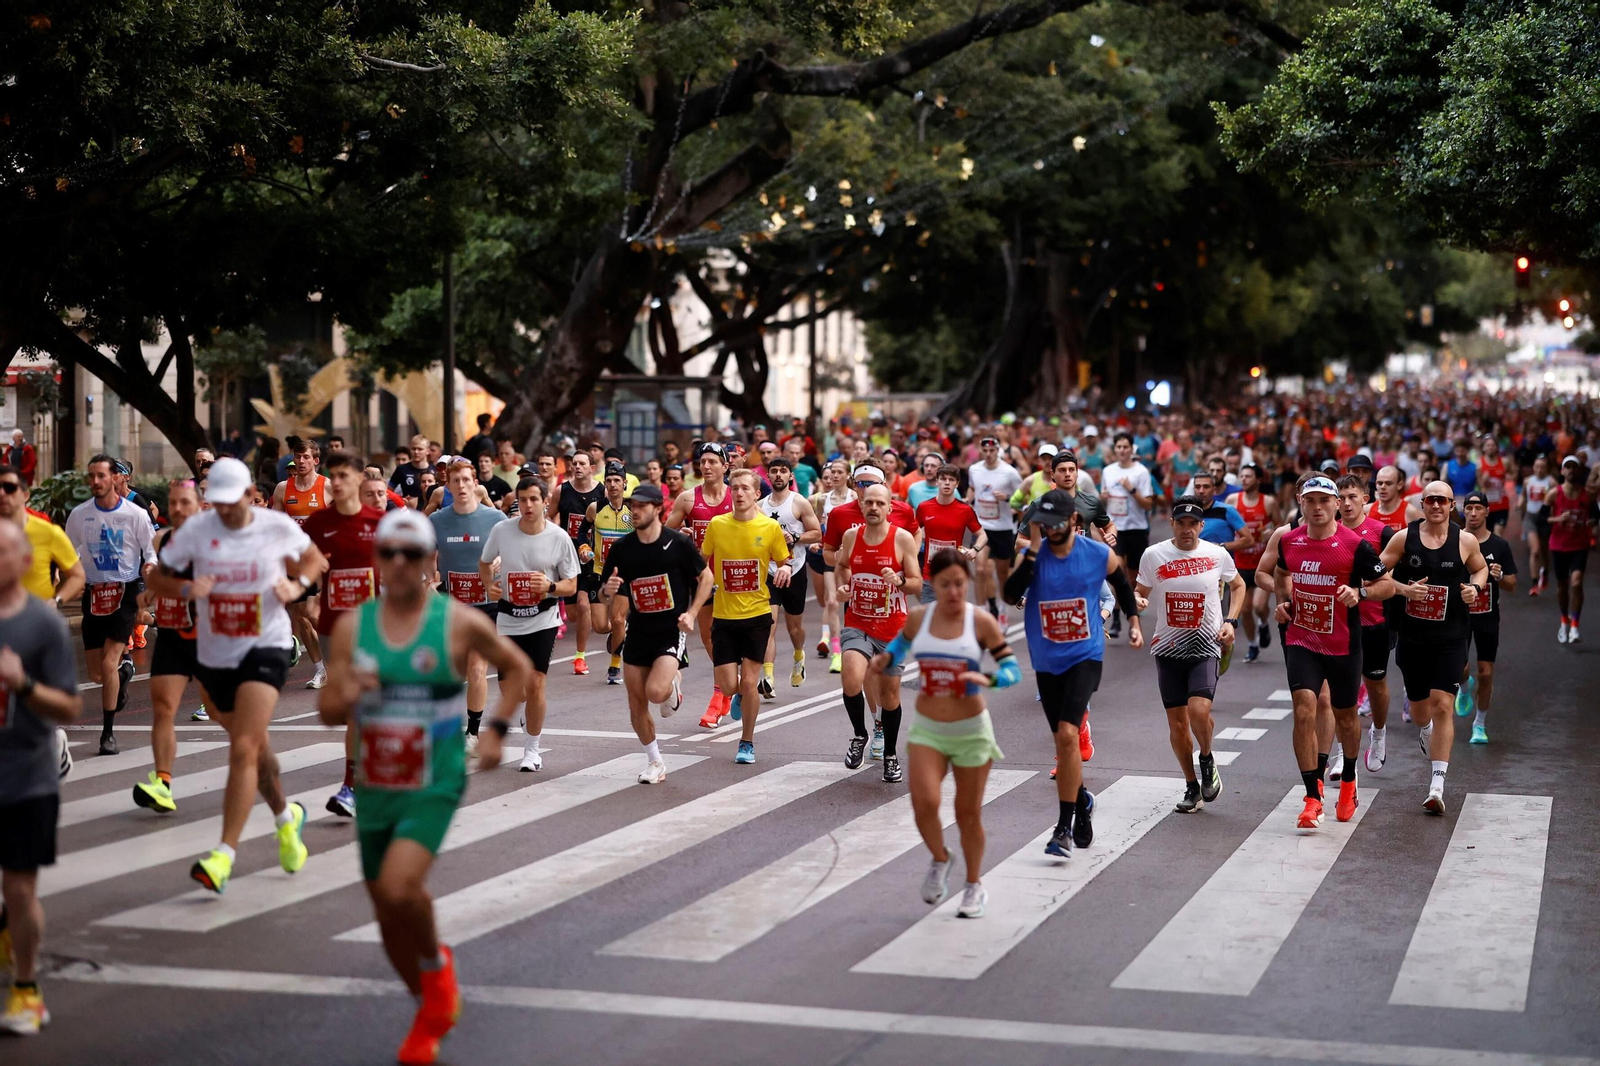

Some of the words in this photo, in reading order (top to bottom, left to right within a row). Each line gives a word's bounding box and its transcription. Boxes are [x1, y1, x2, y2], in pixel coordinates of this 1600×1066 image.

[311, 493, 317, 502] 1
[1166, 560, 1208, 572] DESPENSA
[1301, 560, 1321, 573] PEAK
[458, 580, 473, 588] 726
[516, 580, 531, 588] 216
[1291, 573, 1337, 586] ERFORMANCE
[639, 585, 659, 595] 2512
[860, 590, 878, 599] 2423
[1174, 592, 1201, 600] GENERALI
[1174, 600, 1194, 609] 1399
[1303, 602, 1317, 612] 579
[512, 605, 539, 617] 226ERS
[1051, 610, 1073, 620] 1497
